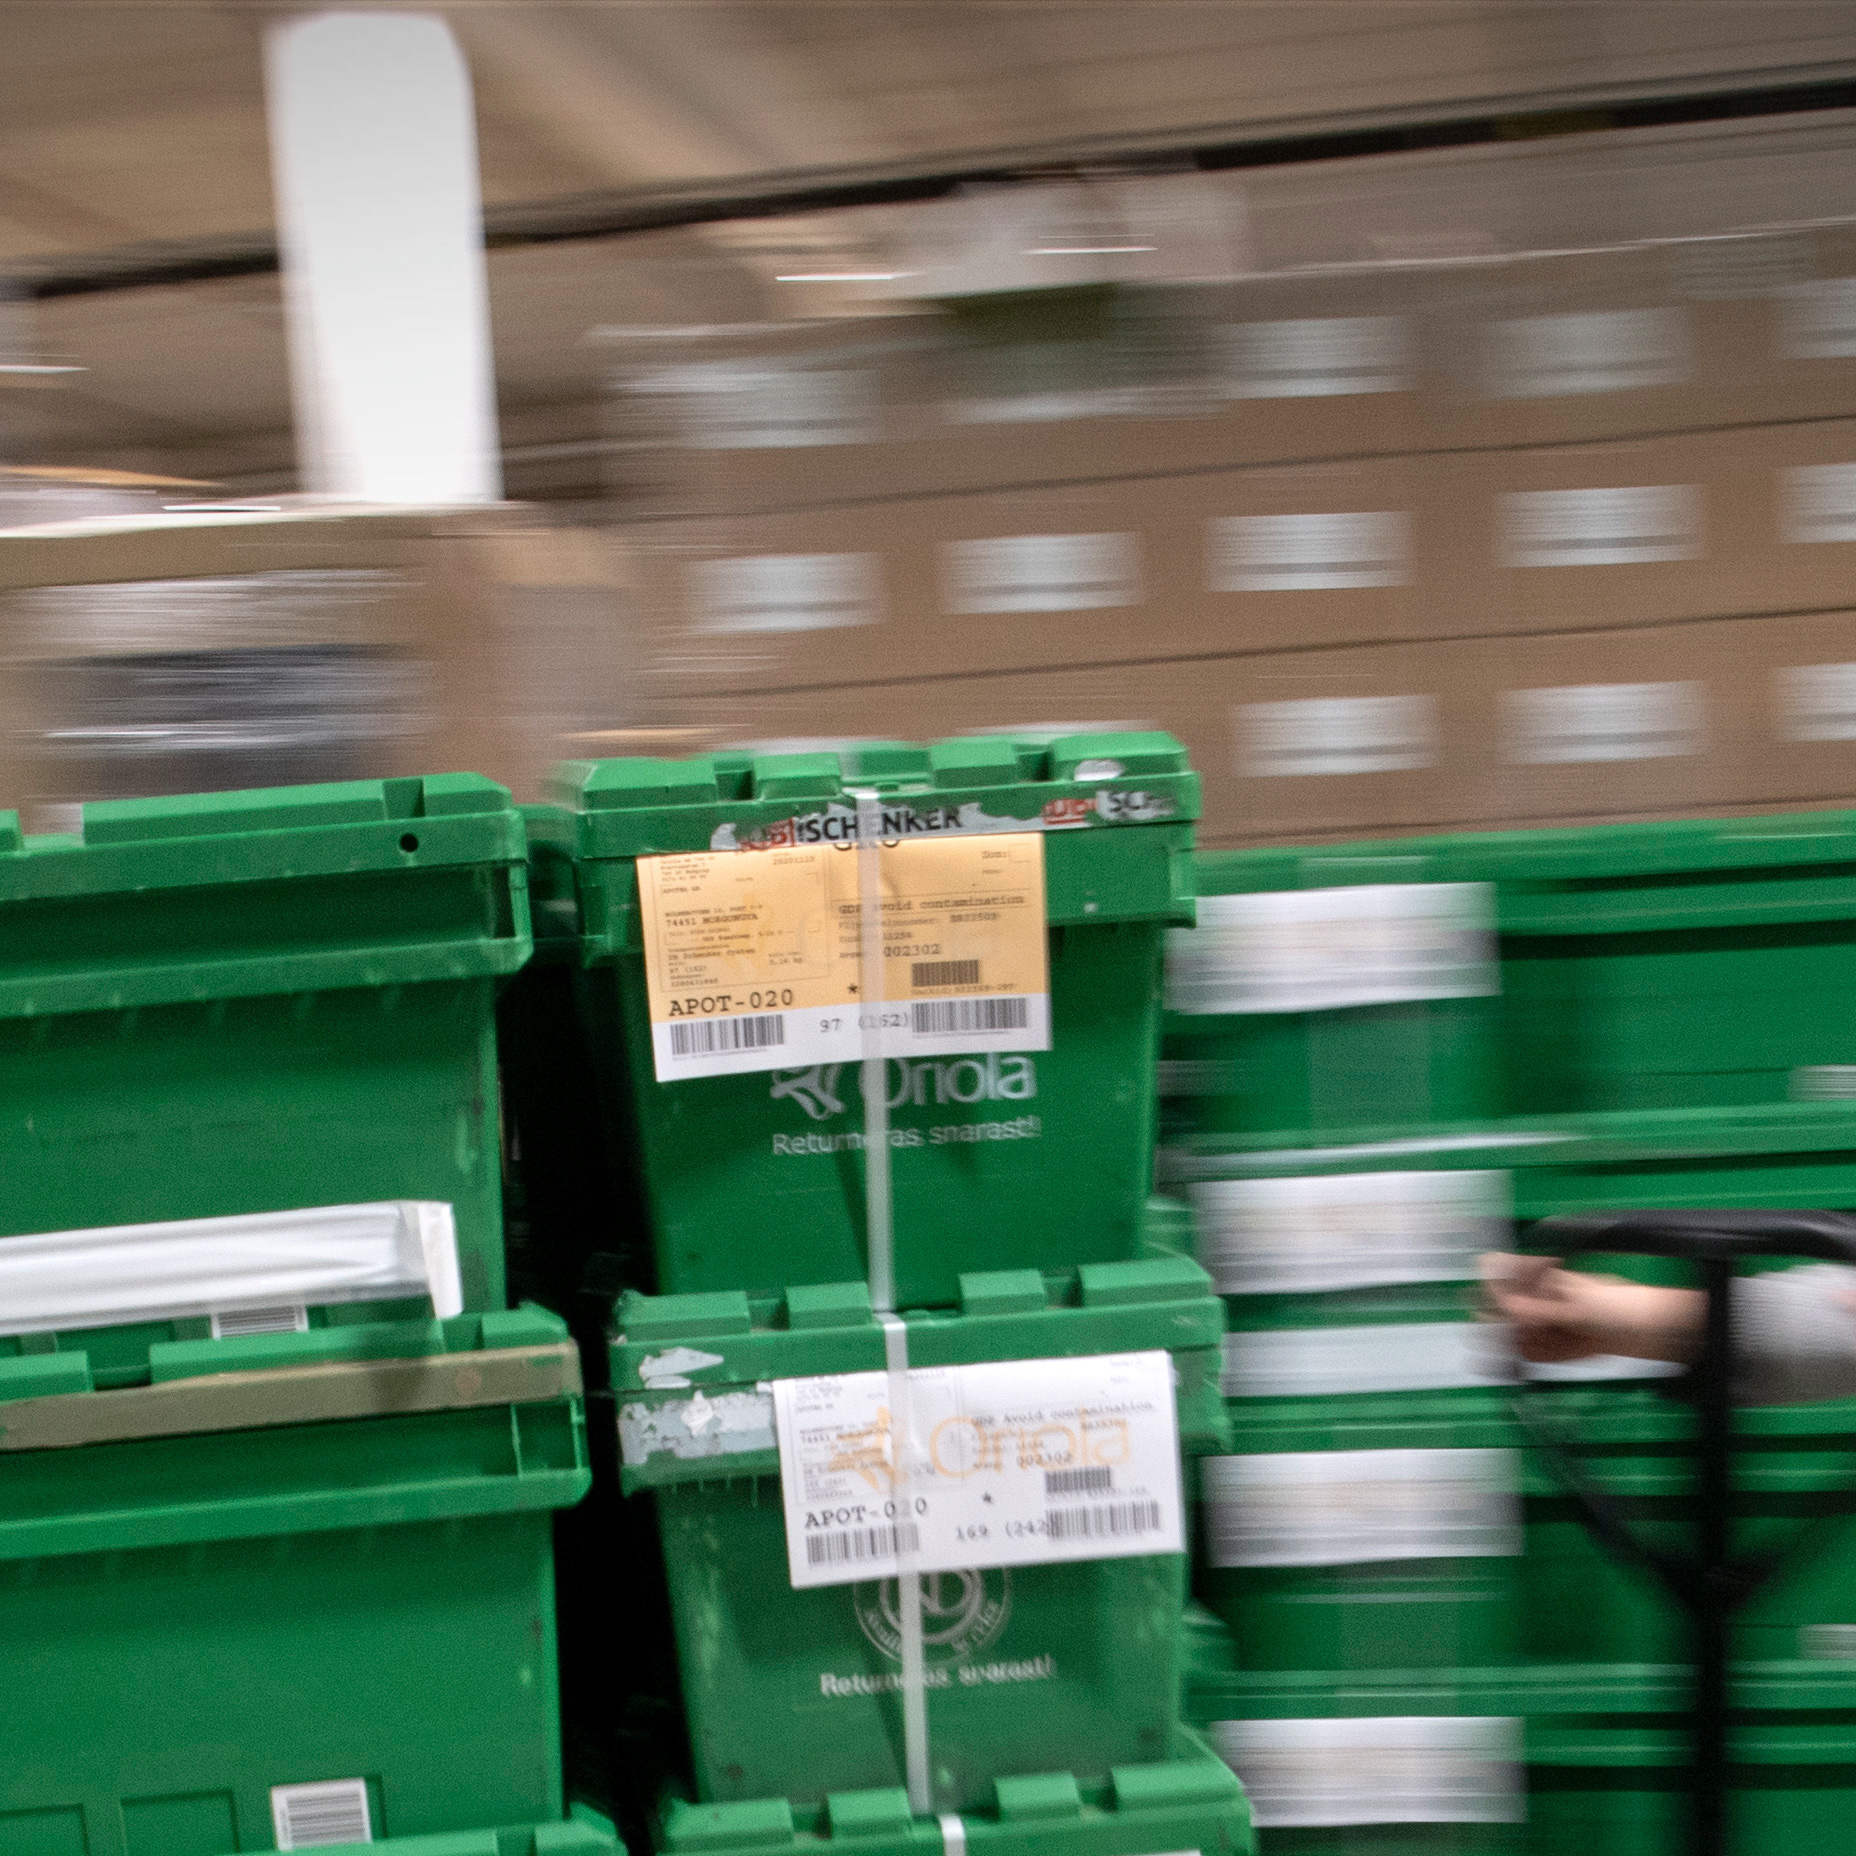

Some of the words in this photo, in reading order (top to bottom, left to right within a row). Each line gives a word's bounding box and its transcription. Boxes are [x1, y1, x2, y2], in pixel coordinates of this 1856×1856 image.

[873, 900, 913, 912] void
[919, 894, 1026, 911] contamination
[668, 988, 796, 1018] APOT-020
[819, 1018, 843, 1034] 97
[772, 1127, 925, 1156] Returnas
[929, 1406, 1131, 1480] Oriola
[819, 1669, 952, 1697] Returnas
